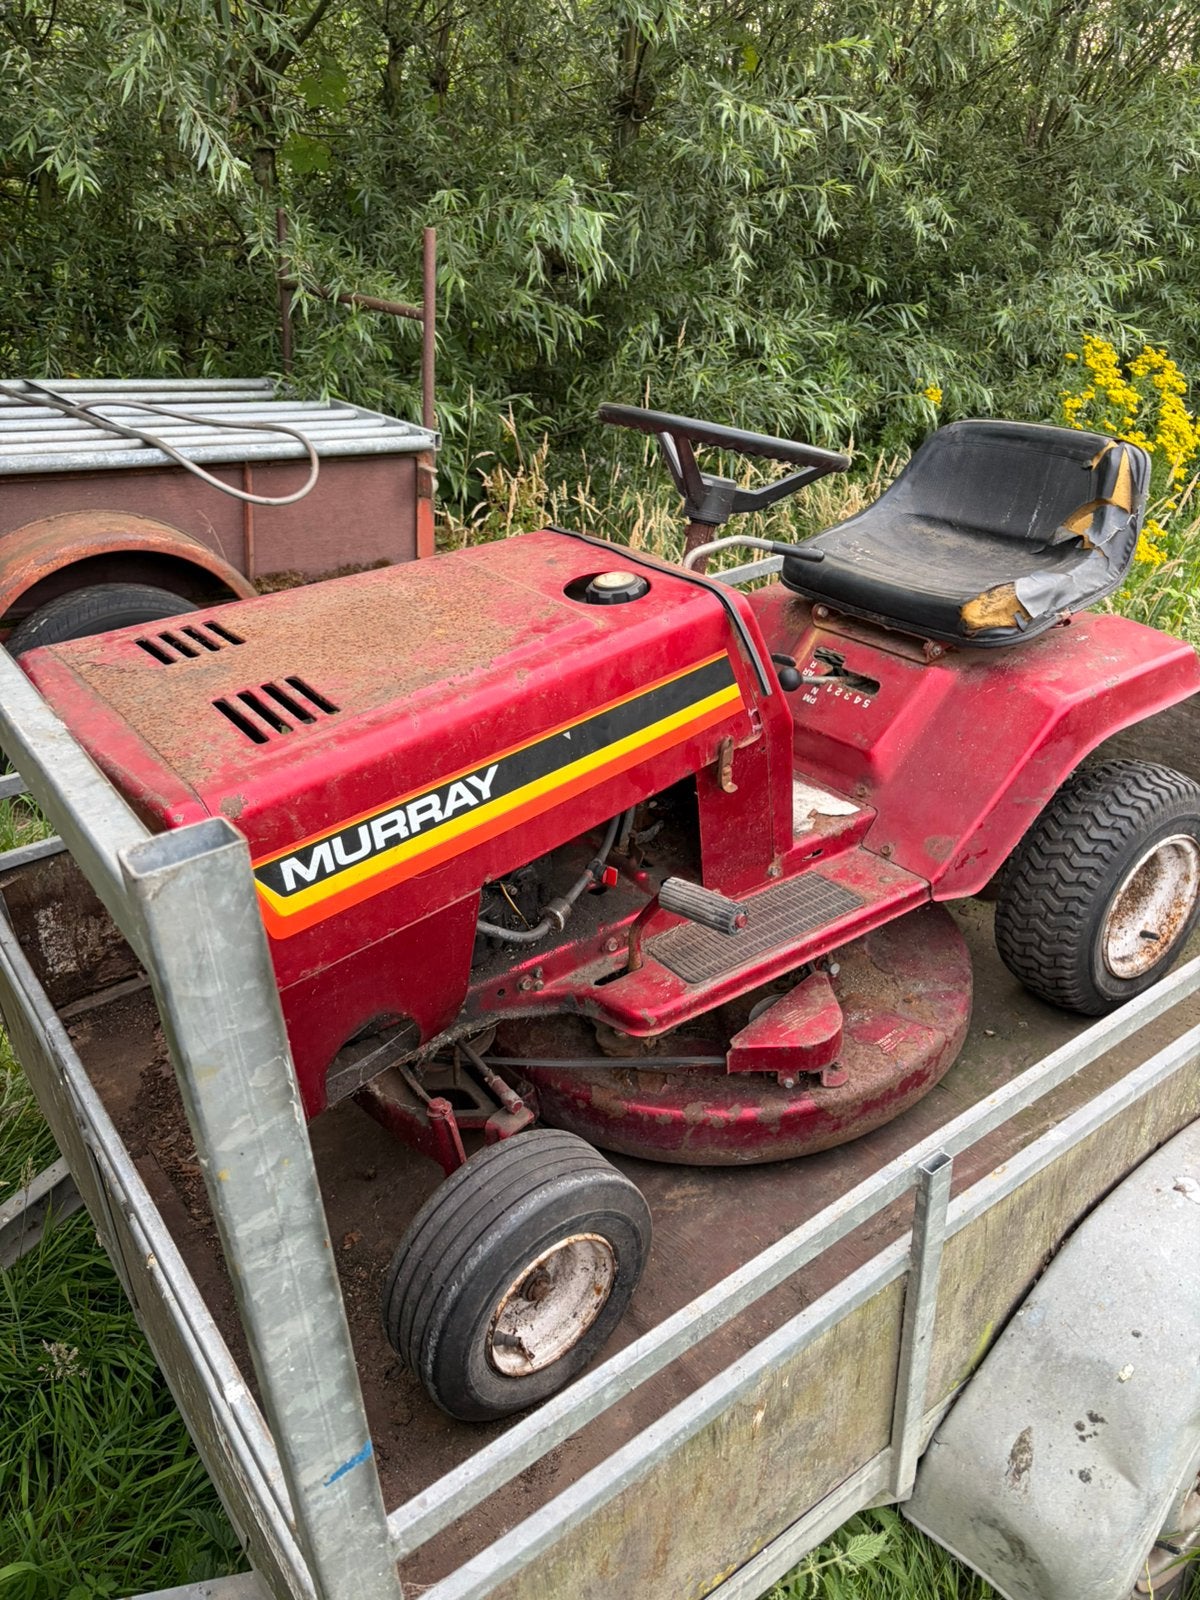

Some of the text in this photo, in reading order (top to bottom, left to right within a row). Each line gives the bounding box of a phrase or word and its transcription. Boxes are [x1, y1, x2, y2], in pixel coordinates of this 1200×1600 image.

[810, 661, 818, 669] R
[810, 687, 819, 695] N
[826, 684, 871, 708] 5 4 3 2 1
[802, 693, 817, 704] PM
[279, 764, 499, 892] MURRAY
